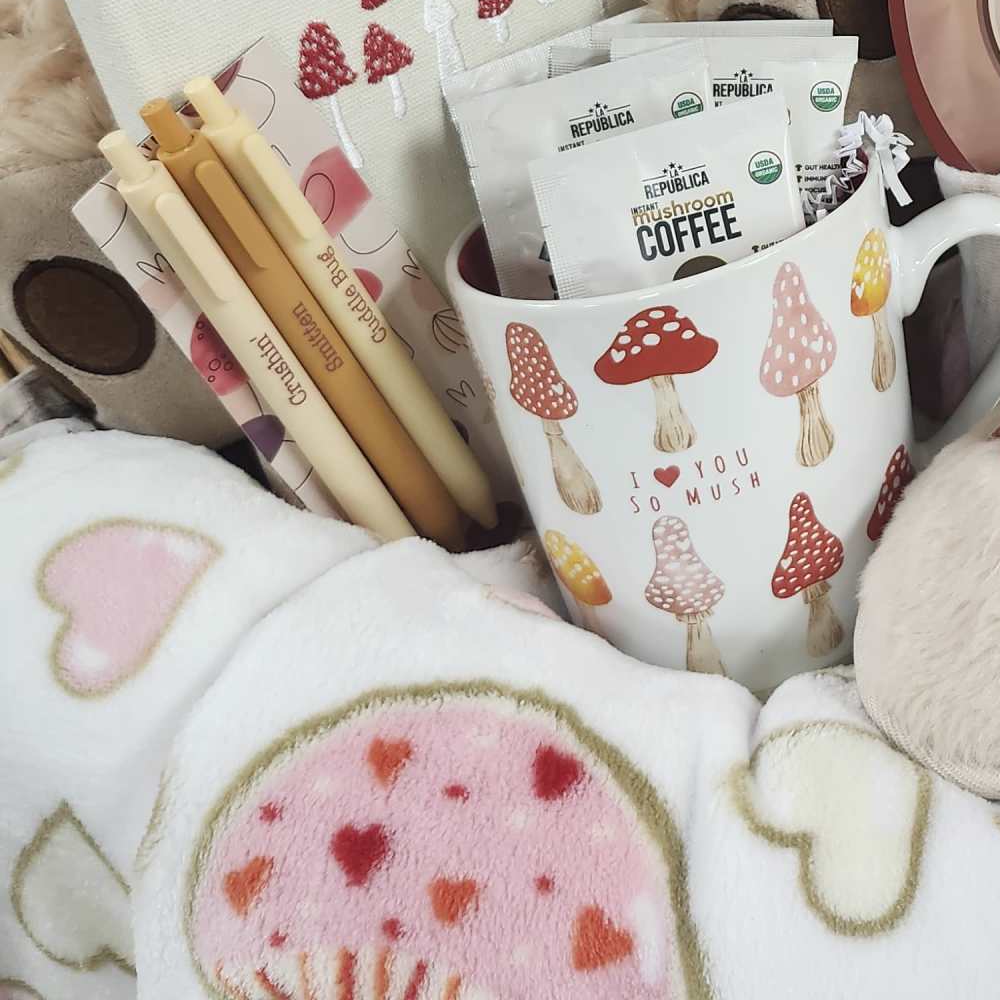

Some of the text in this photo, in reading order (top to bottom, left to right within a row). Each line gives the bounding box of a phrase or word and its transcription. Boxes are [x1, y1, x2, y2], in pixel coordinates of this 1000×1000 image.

[677, 97, 696, 109] USDA
[817, 87, 835, 95] USDA
[594, 107, 605, 118] LA
[669, 169, 679, 179] LA
[755, 157, 775, 169] USDA
[630, 201, 659, 214] INSTANT
[632, 191, 734, 226] mushroom
[636, 203, 742, 261] COFFEE
[317, 245, 388, 344] Cuddle Bug
[292, 301, 345, 373] Smitten
[630, 448, 749, 489] I YOU
[630, 472, 761, 514] SO MUSH
